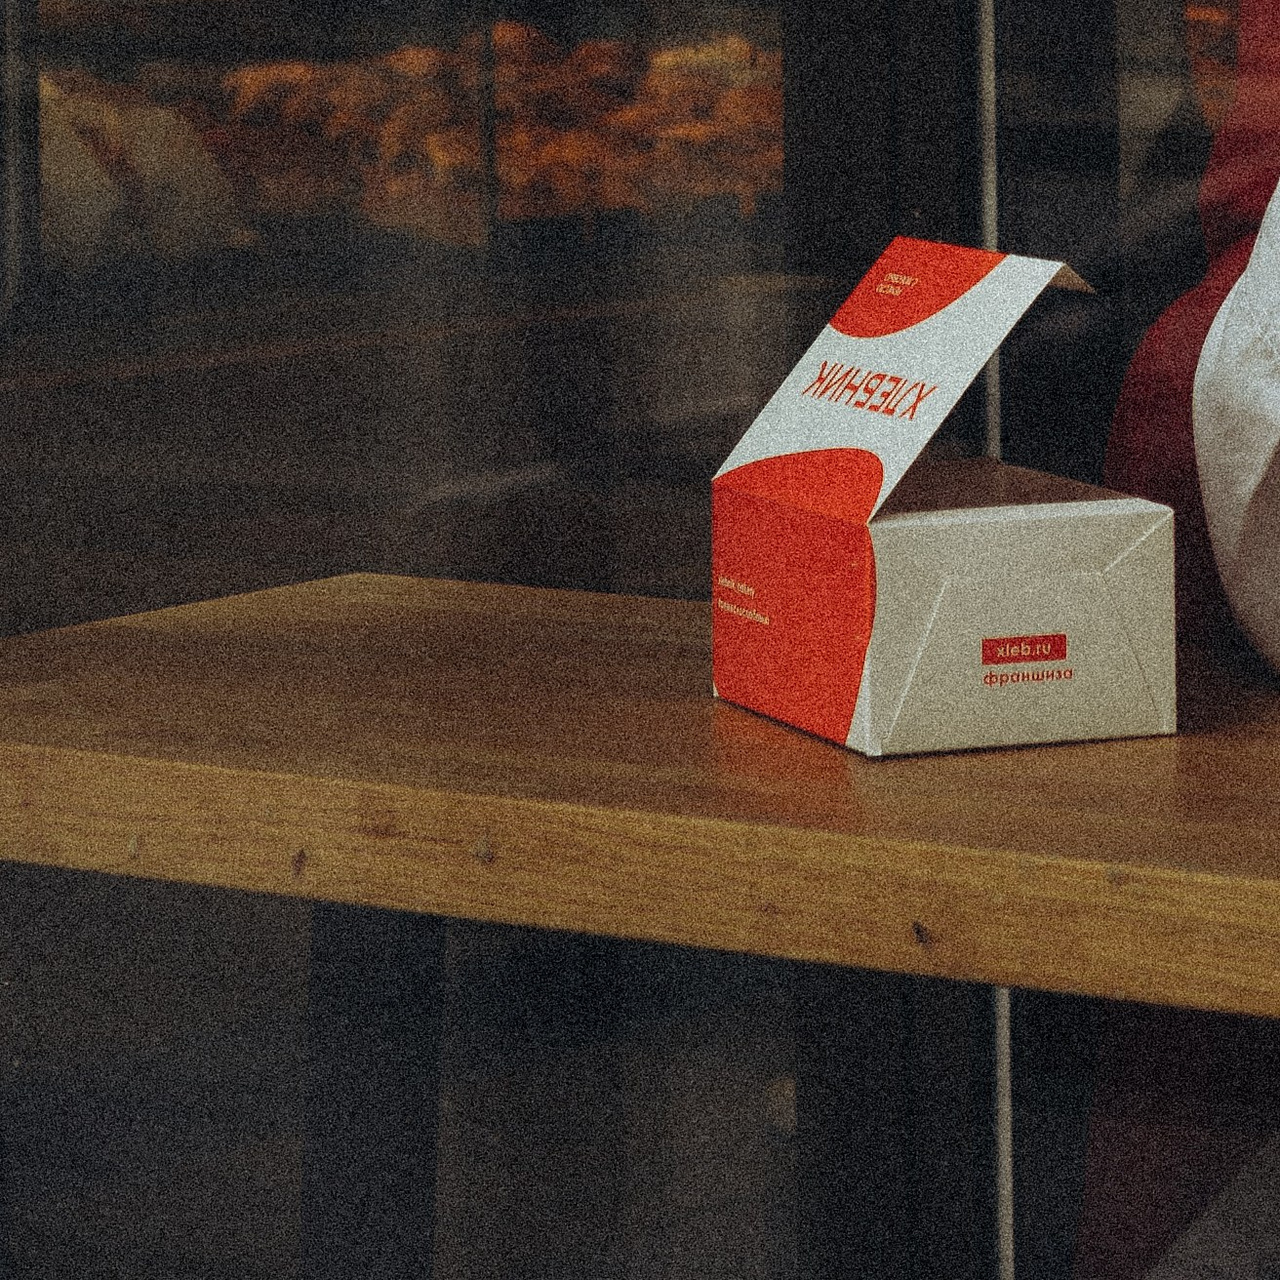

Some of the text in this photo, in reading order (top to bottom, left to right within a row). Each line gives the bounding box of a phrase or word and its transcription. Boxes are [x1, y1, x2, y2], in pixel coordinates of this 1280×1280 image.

[801, 360, 939, 422] ХЛЕБНИК
[996, 642, 1052, 658] xleb.ru
[983, 668, 1074, 688] франшиза
